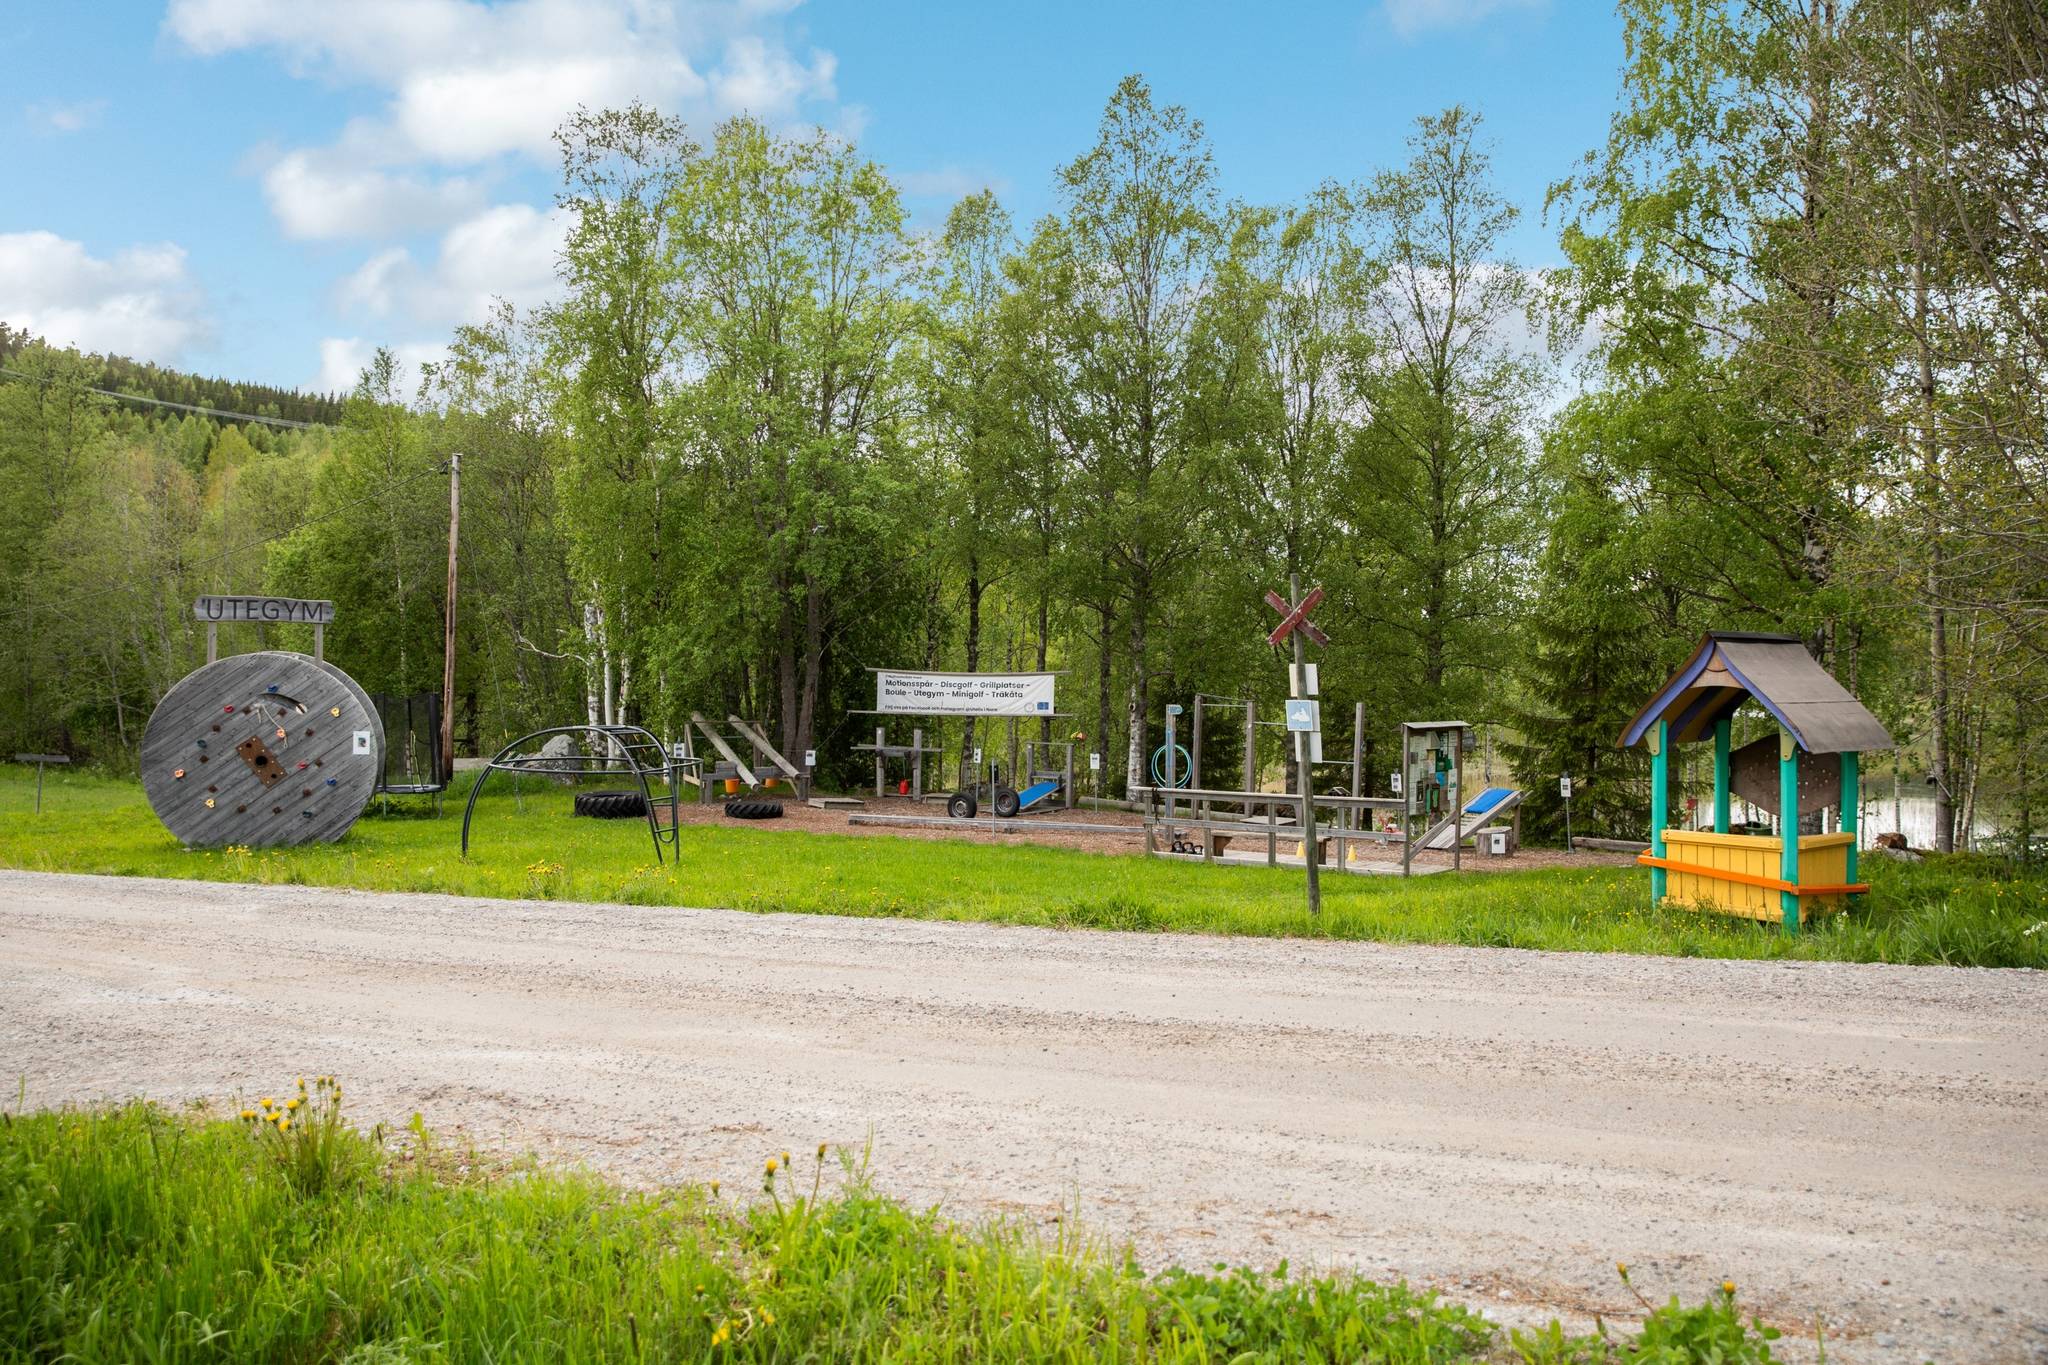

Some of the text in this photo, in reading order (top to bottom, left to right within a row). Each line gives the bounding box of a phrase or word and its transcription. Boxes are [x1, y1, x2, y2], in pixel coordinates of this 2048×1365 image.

[207, 598, 323, 621] UTEGYM
[885, 679, 933, 689] Motionsspår
[940, 681, 972, 690] Discgolf
[980, 681, 1025, 690] Grillplatser
[885, 688, 907, 696] Boule
[913, 689, 945, 699] Utegym
[951, 690, 984, 700] Minigolf
[992, 690, 1023, 698] Träkåta
